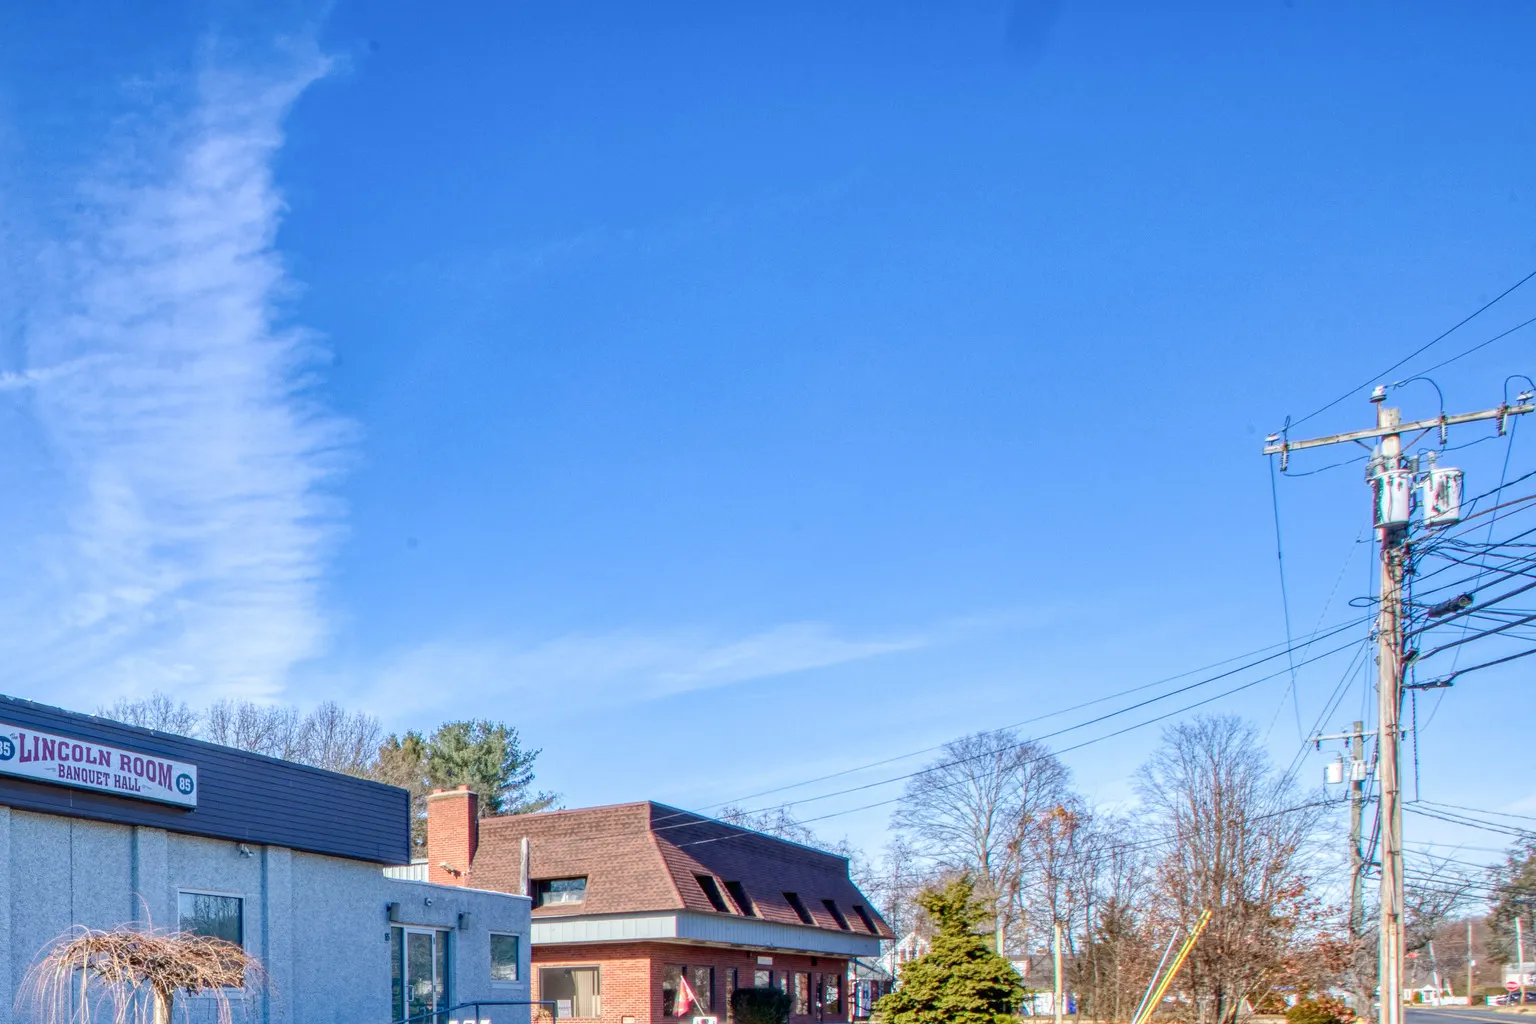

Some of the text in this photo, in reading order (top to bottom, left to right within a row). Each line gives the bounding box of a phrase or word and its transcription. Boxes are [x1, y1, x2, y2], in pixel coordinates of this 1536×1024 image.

[18, 732, 112, 768] LINCOLN
[119, 752, 173, 792] ROOM
[57, 763, 141, 793] BANQUET HALL
[178, 776, 191, 792] 85
